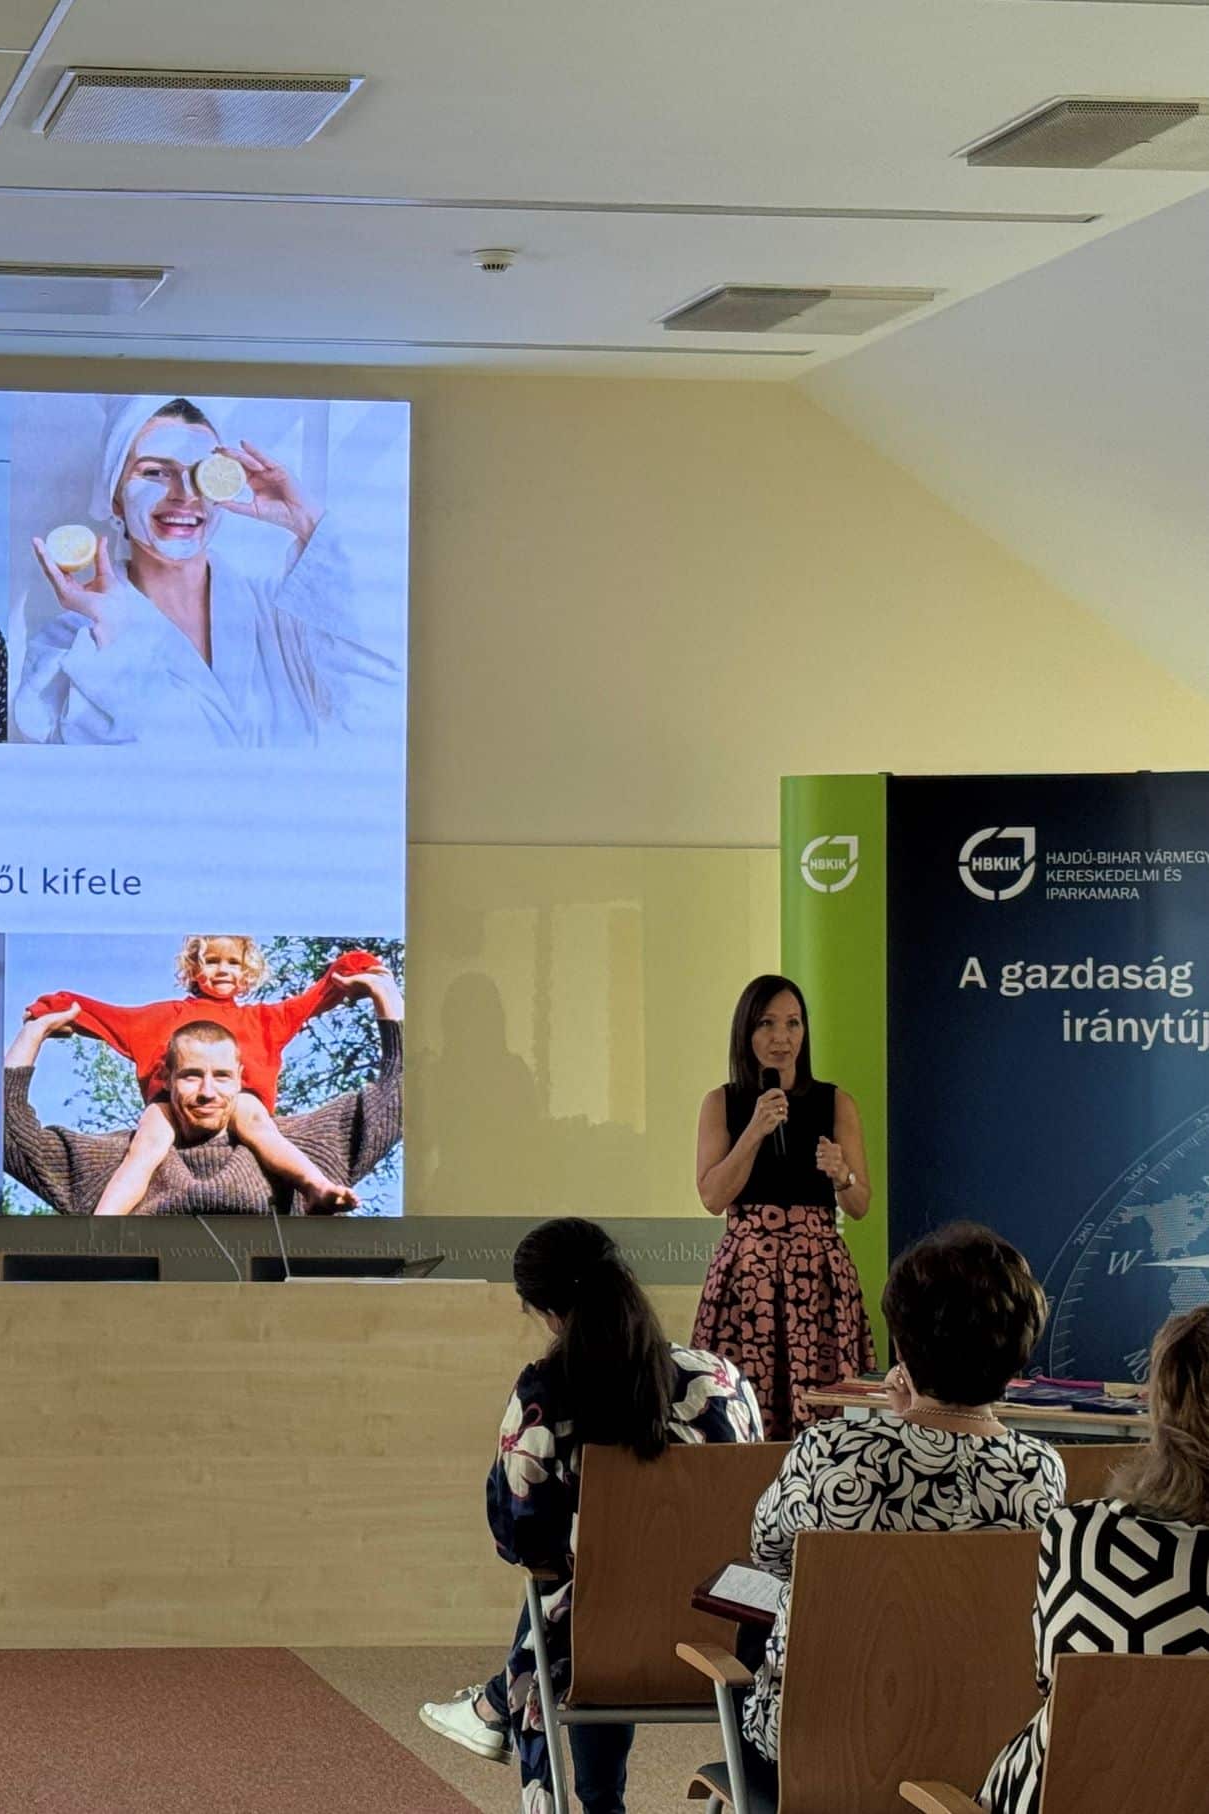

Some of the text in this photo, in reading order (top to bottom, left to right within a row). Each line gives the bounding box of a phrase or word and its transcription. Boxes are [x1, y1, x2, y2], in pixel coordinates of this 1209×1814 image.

[810, 858, 847, 871] HBKIK
[971, 856, 1021, 871] HBKIK
[1046, 848, 1142, 865] HAJDÚ-BIHAR
[42, 866, 142, 896] kifele
[1046, 865, 1183, 882] KERESKEDELMI ÉS
[1046, 886, 1140, 900] IPARKAMARA
[958, 955, 1195, 998] A gazdaság
[1106, 1249, 1142, 1275] W
